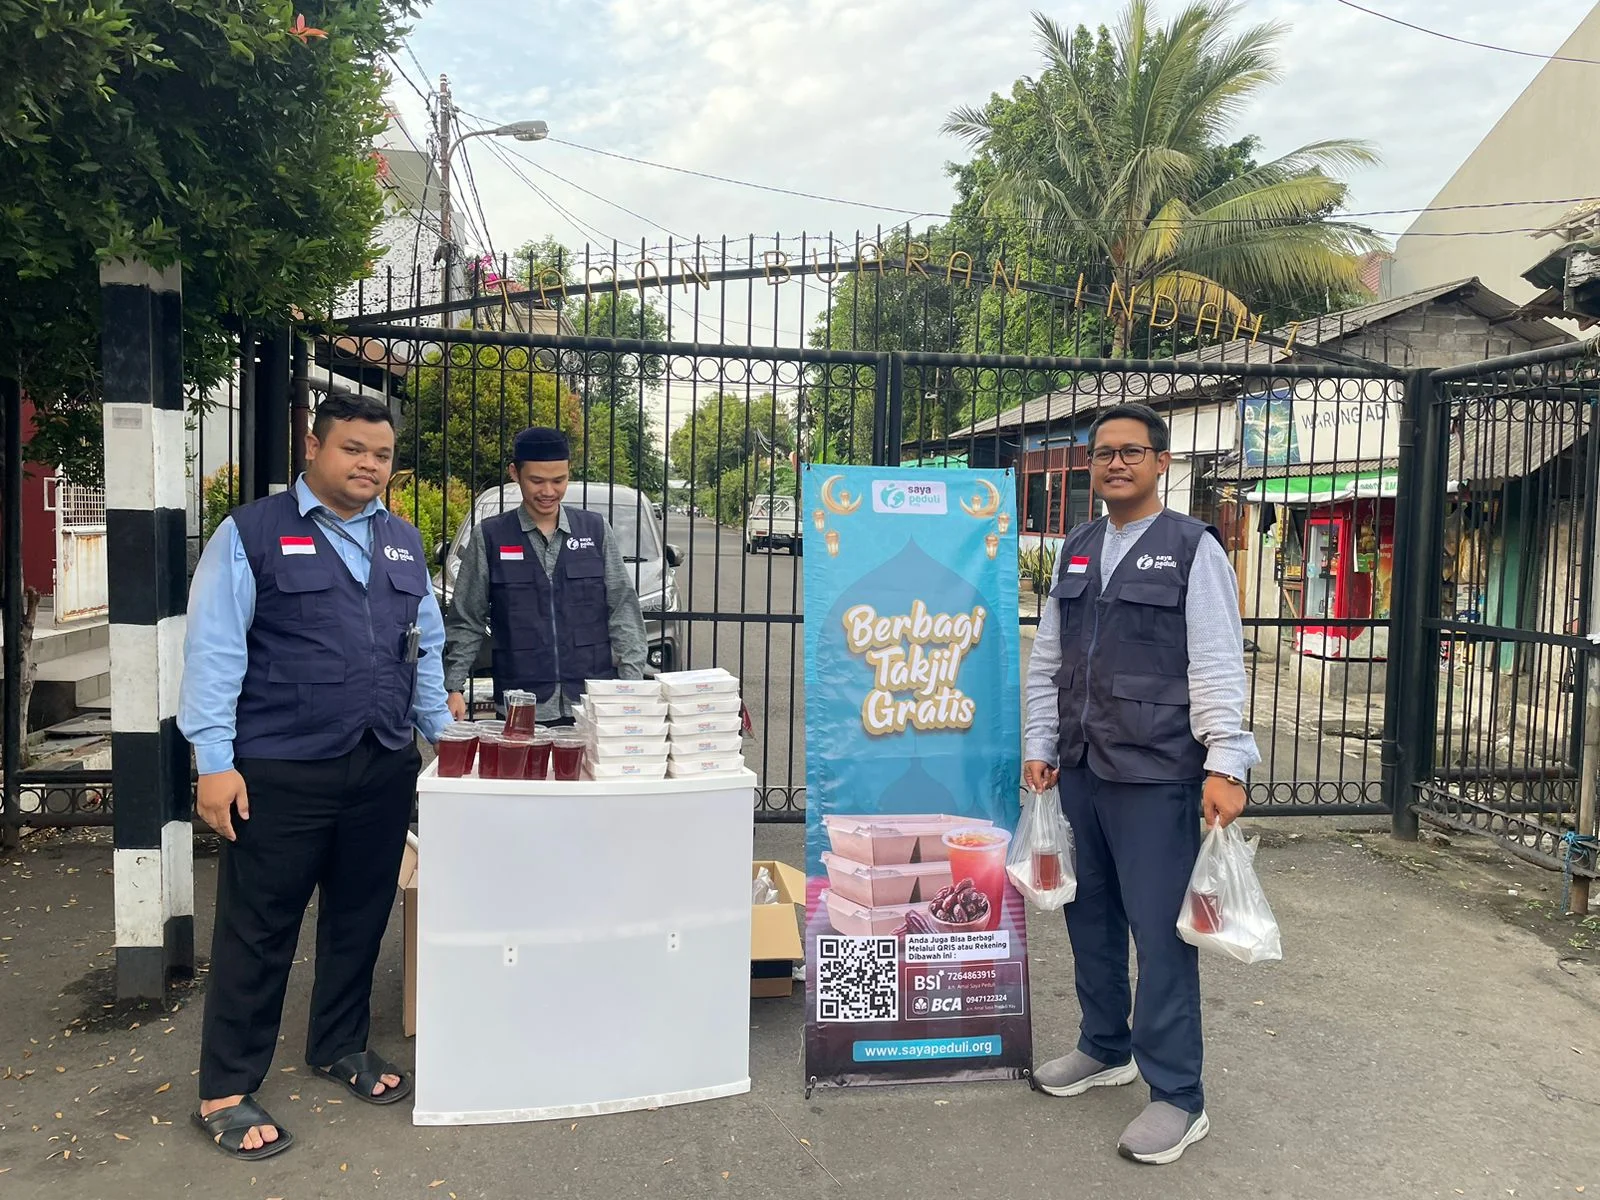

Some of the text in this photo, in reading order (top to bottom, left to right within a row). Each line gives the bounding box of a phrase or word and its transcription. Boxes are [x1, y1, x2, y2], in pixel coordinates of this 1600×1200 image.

[484, 254, 711, 315] TAMAN
[763, 242, 1021, 298] BUARAN
[1074, 272, 1263, 348] INDAH
[907, 486, 932, 495] saya
[909, 495, 940, 506] peduli
[845, 600, 986, 651] Berbagi
[868, 644, 961, 696] Takjil
[865, 686, 975, 731] Gratis
[908, 942, 1007, 952] Melalui QRIS atau Rekening
[930, 936, 948, 944] Juga
[950, 935, 966, 943] Bisa
[967, 934, 994, 943] Berbagi
[914, 970, 997, 991] BSI 7264863915
[931, 997, 962, 1012] BCA
[965, 994, 1008, 1004] 0947122324
[864, 1041, 992, 1056] www.sayapeduli.org
